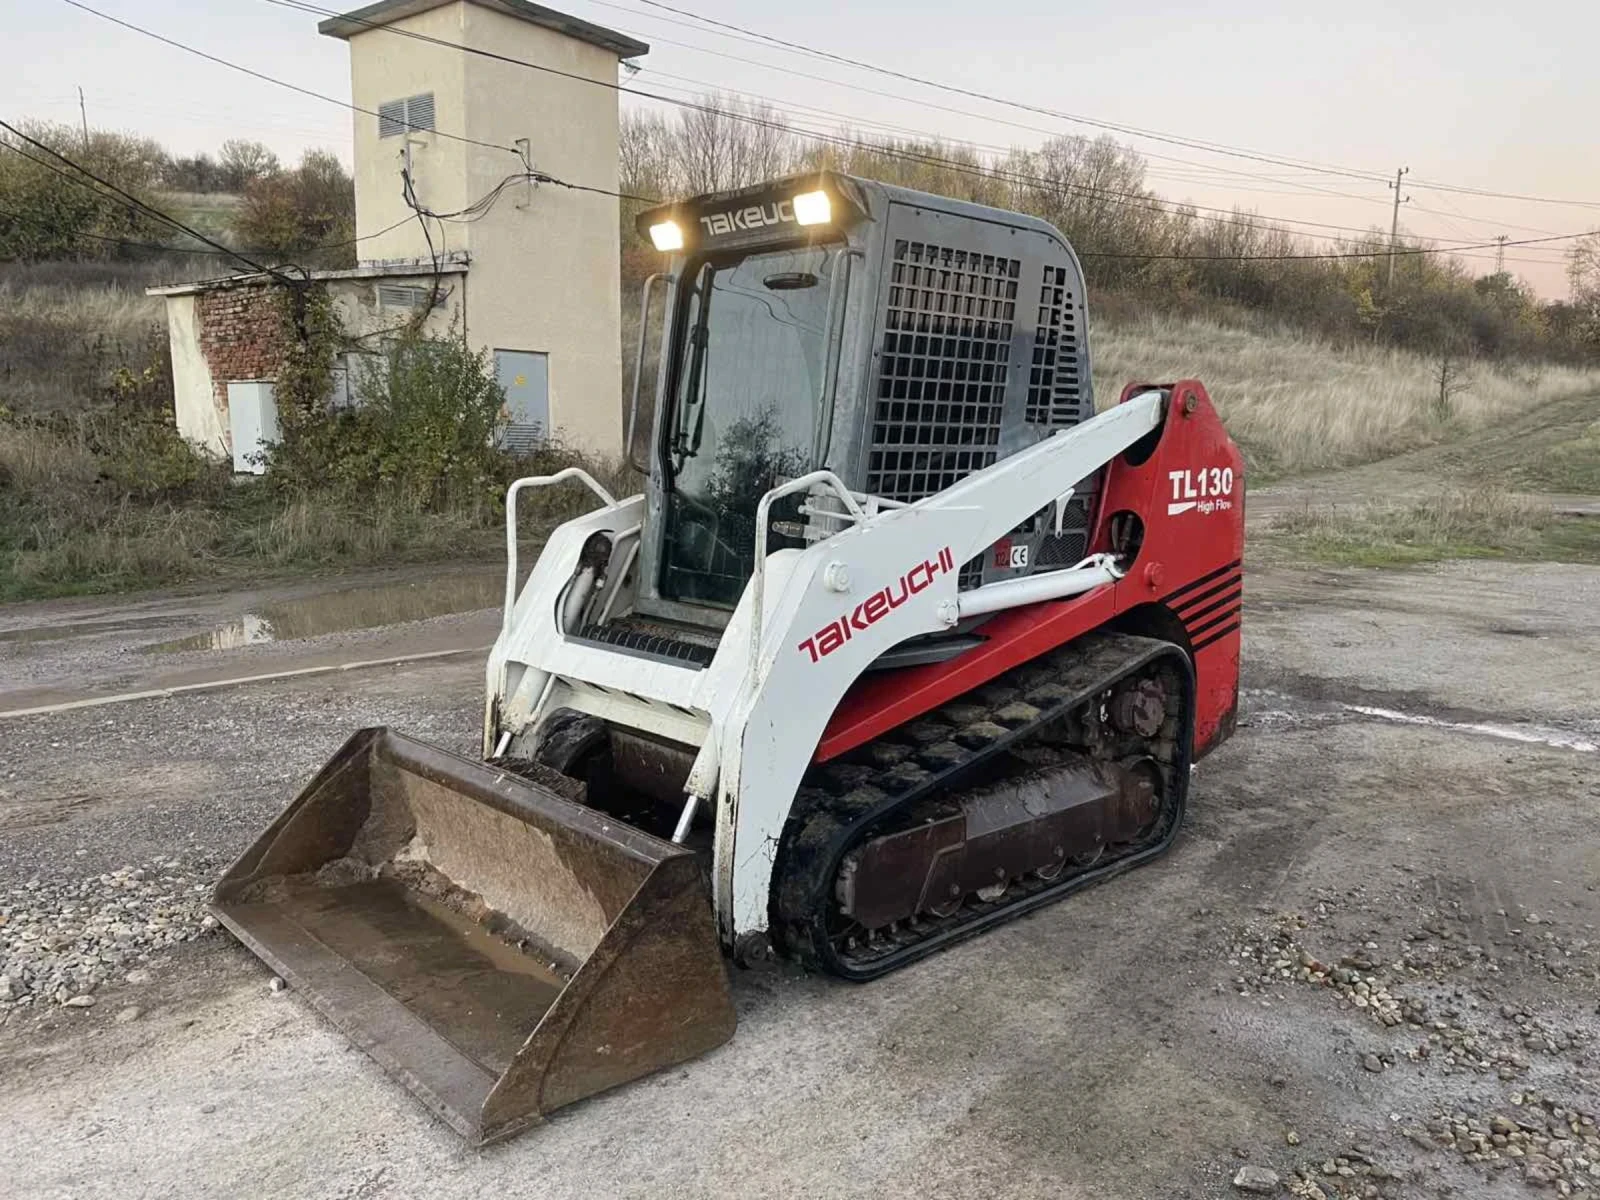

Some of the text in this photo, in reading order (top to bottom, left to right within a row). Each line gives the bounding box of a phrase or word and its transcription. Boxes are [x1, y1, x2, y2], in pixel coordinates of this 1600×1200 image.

[700, 201, 797, 237] TAKEUC
[1169, 467, 1233, 500] TL130
[1197, 500, 1215, 515] High
[1011, 547, 1027, 566] CE
[798, 546, 954, 663] TAKEUCHI
